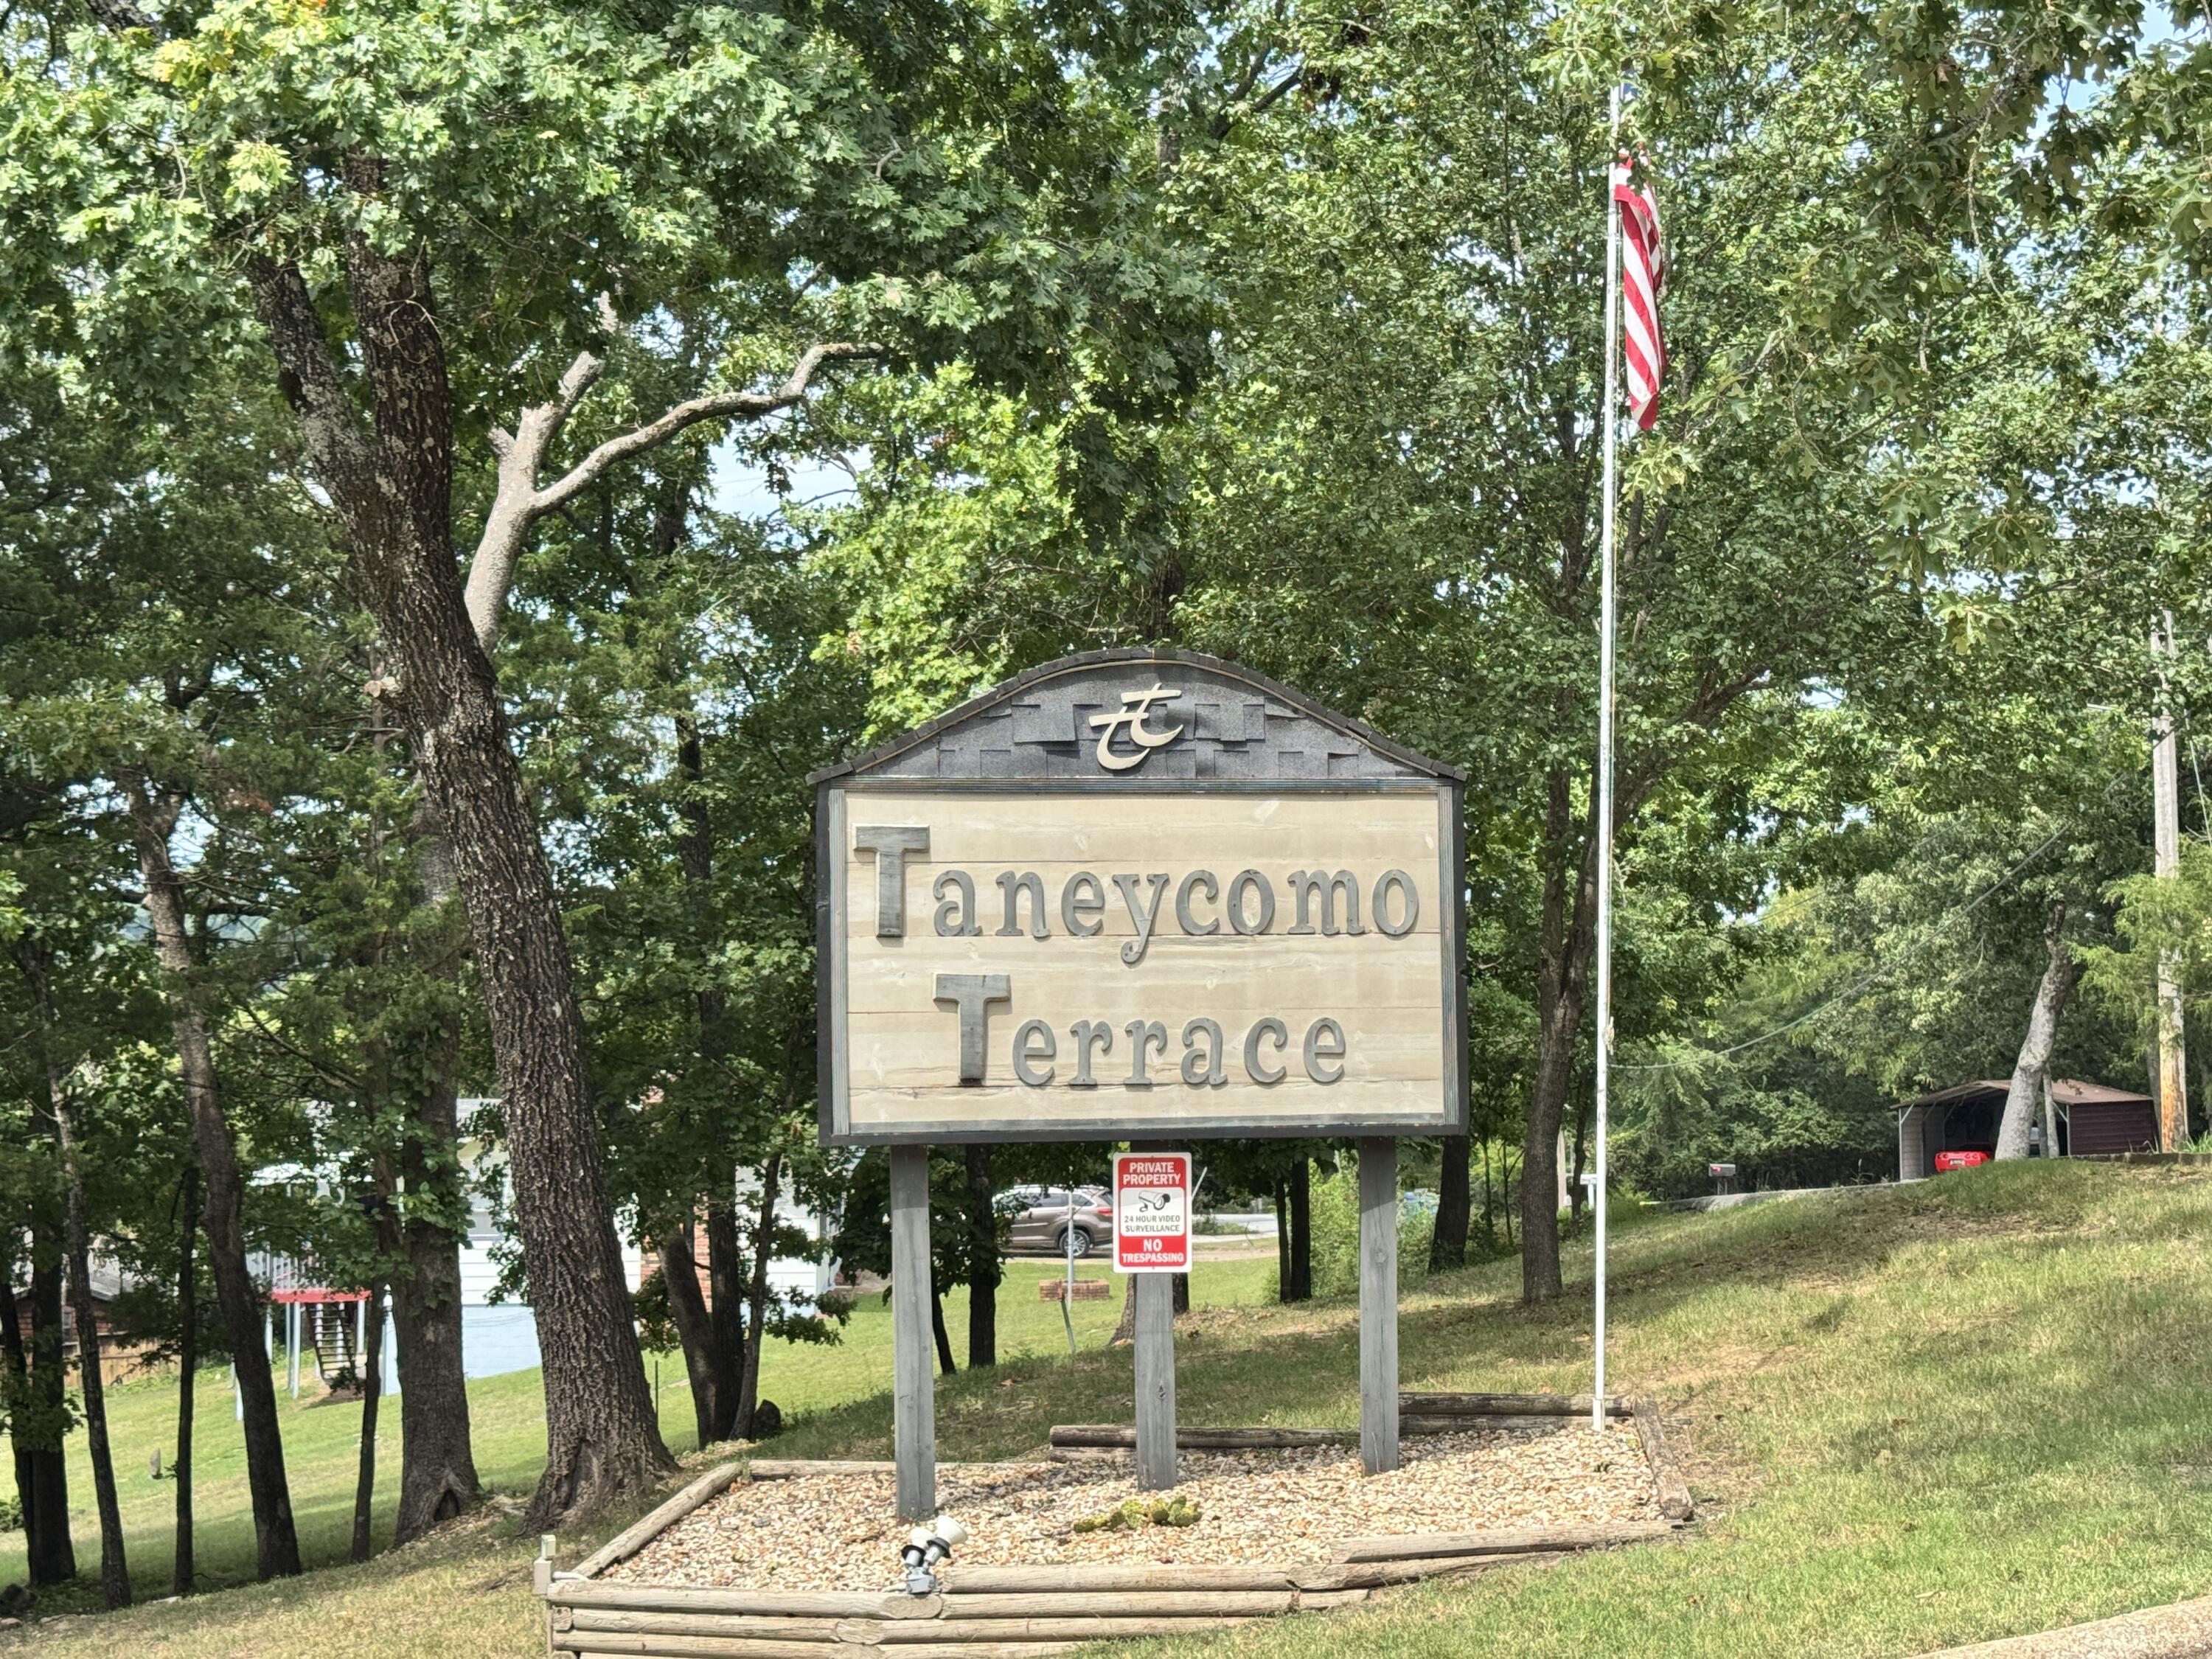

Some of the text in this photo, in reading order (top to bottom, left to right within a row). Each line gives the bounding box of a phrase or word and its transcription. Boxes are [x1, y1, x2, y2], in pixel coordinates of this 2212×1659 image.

[853, 824, 1419, 964] Taneycomo
[933, 973, 1347, 1088] Terrace
[1130, 1162, 1175, 1173] PRIVATE
[1123, 1174, 1180, 1185] PROPERTY
[1143, 1239, 1163, 1252] NO
[1121, 1253, 1184, 1263] TRESPASSING
